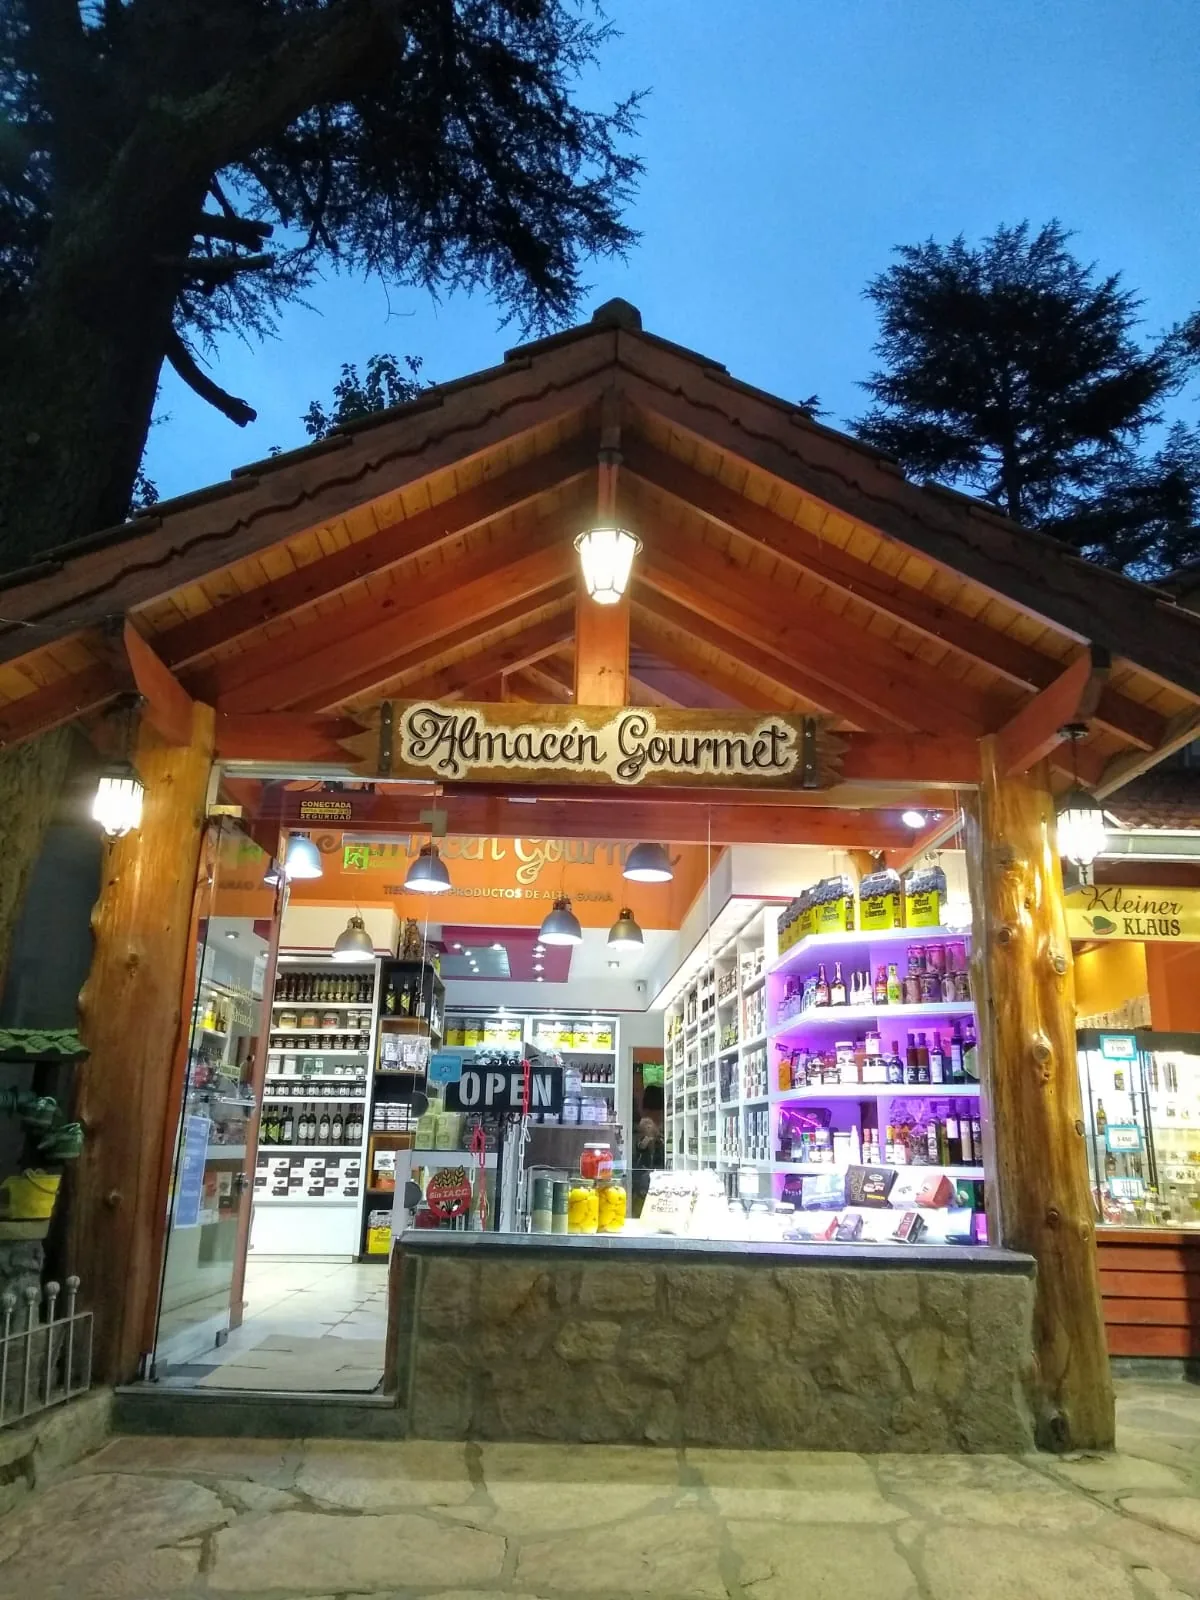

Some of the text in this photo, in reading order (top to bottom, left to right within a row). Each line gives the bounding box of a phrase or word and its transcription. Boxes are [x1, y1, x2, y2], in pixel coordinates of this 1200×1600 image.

[408, 708, 792, 779] Almacén Gourmet
[447, 886, 521, 898] PRODUCTOS
[525, 889, 539, 899] DE
[1081, 884, 1183, 915] Kleiner
[1123, 918, 1181, 936] KLAUS
[459, 1071, 552, 1107] OPEN
